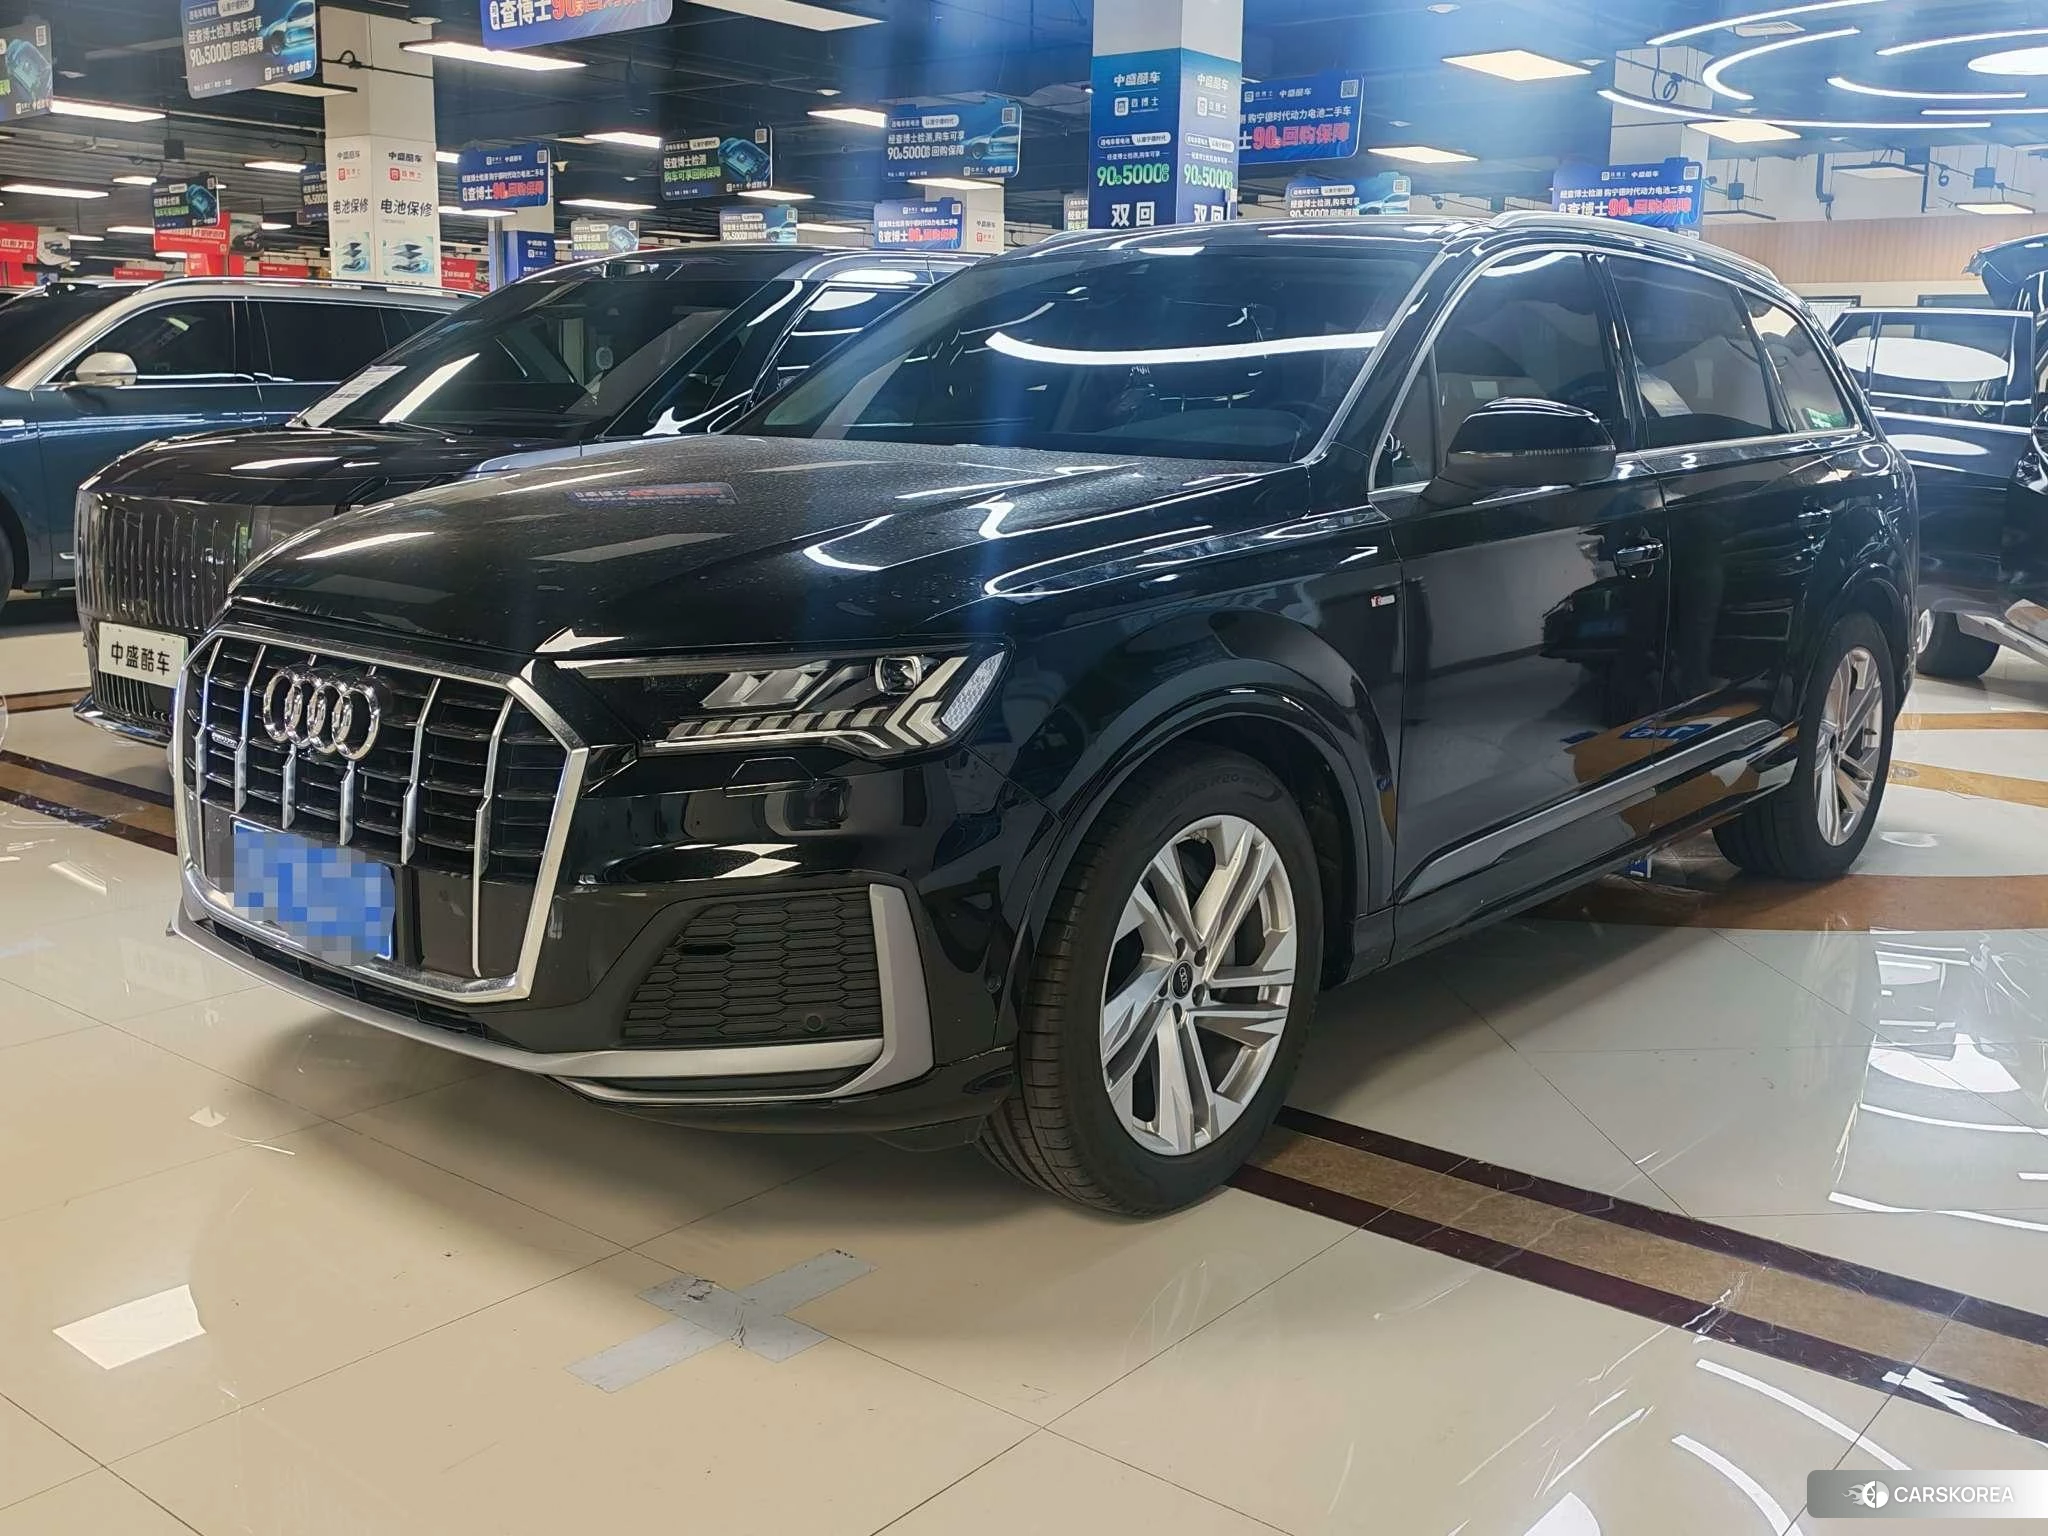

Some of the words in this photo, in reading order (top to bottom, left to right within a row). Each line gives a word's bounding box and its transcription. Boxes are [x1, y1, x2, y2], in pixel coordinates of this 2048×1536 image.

[1114, 71, 1161, 87] 中盛酷车
[1197, 73, 1229, 91] 中盛酷车
[333, 198, 369, 214] 电池保修
[381, 198, 433, 217] 电池保修
[1111, 201, 1155, 228] 双回
[111, 641, 170, 676] 中盛酷车
